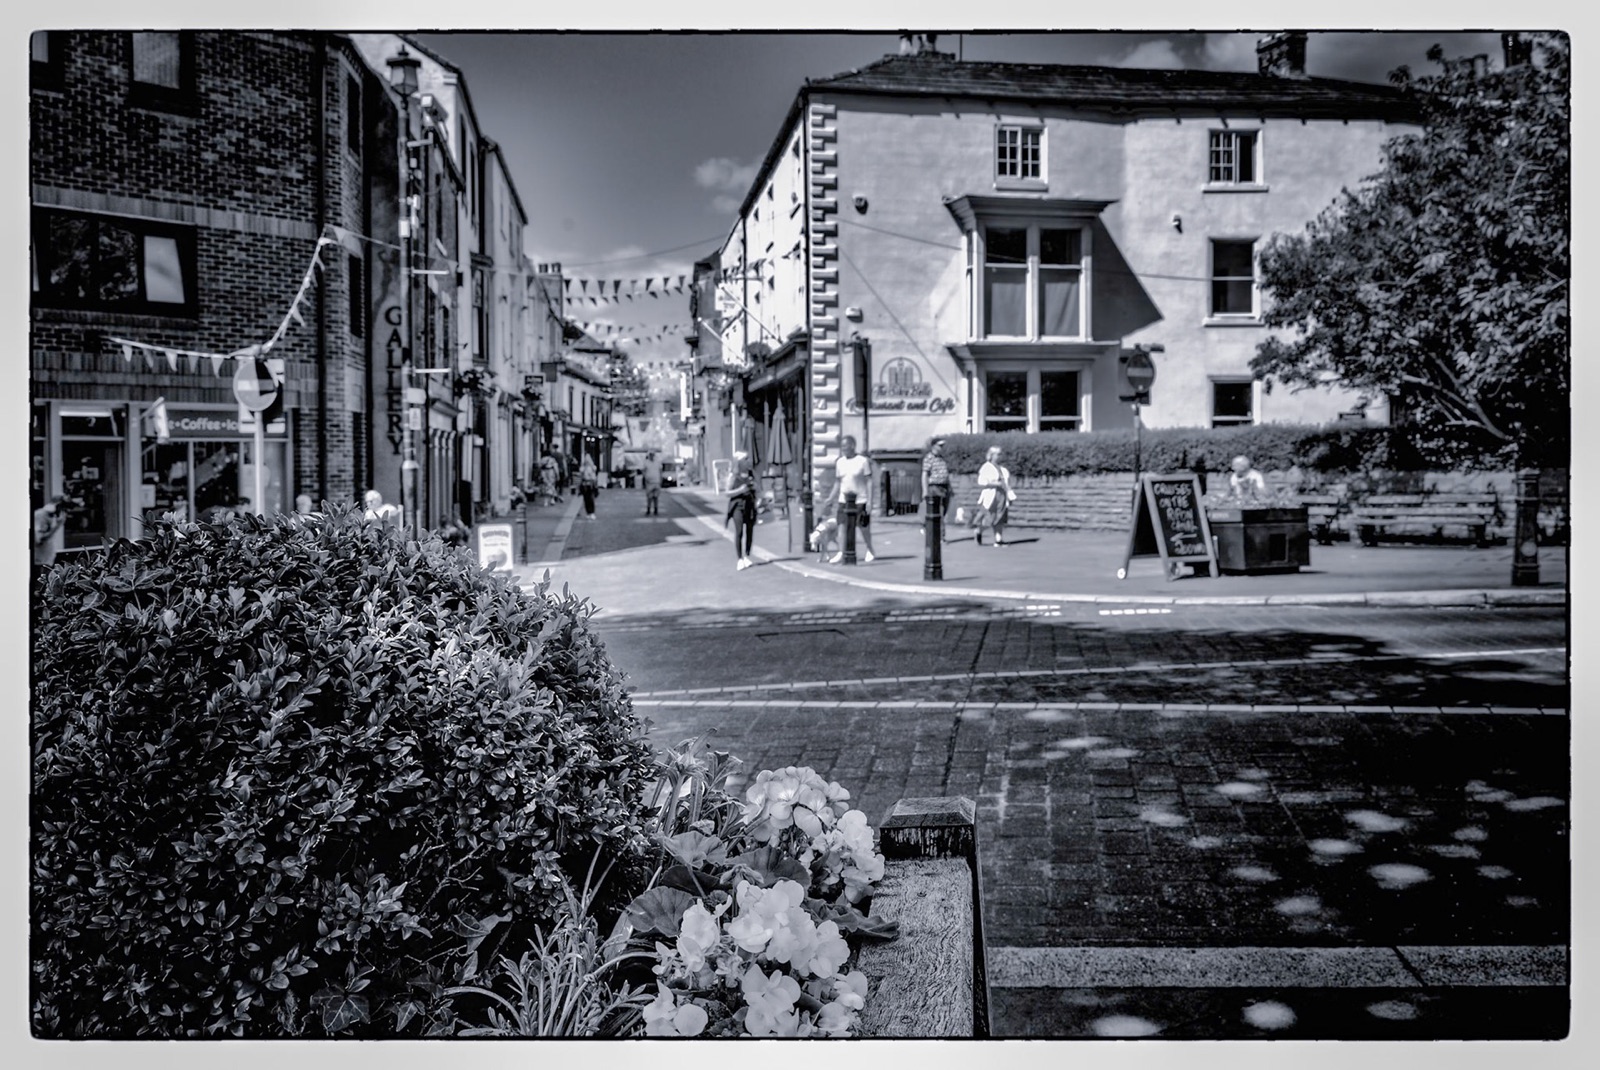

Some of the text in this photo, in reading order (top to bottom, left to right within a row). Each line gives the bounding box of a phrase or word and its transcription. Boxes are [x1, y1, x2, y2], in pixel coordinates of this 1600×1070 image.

[384, 306, 403, 455] GALLERY
[907, 400, 928, 411] and
[181, 417, 221, 430] Coffee
[1172, 495, 1190, 508] THE
